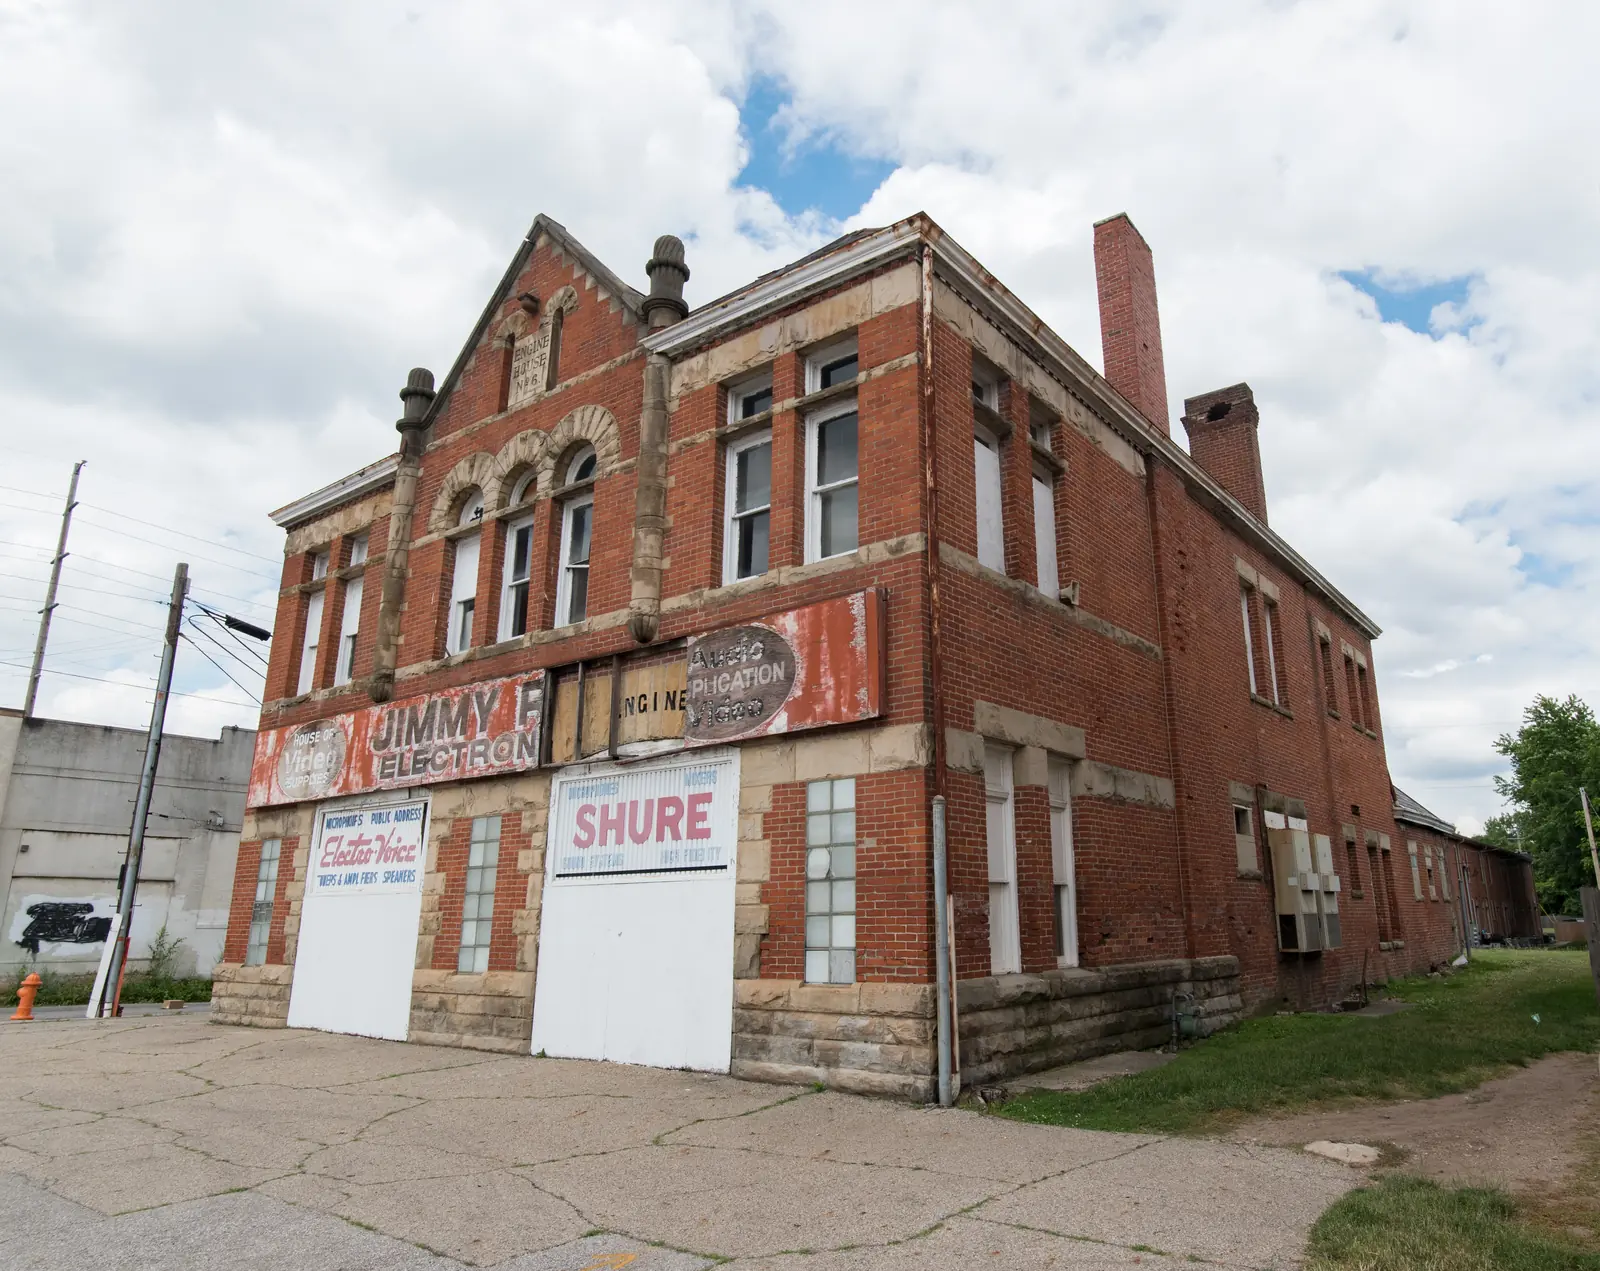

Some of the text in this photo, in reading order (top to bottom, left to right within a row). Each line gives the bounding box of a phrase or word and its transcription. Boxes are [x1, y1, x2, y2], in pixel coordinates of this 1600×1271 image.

[514, 334, 549, 363] ENGINE
[513, 352, 546, 380] HOUSE
[687, 636, 765, 674] Audio
[619, 689, 687, 719] NGINE
[685, 696, 764, 728] Video
[372, 687, 500, 752] JIMMY
[294, 728, 335, 747] HOUSE OF
[285, 747, 337, 774] Video
[378, 731, 538, 780] ELECTRON
[284, 771, 329, 789] SUPPLIES
[371, 811, 391, 825] PUBLIC
[394, 807, 422, 823] ADDRESS
[573, 792, 713, 849] SHURE
[344, 871, 378, 885] AMPLFIERS
[382, 869, 417, 884] SPEAKERS
